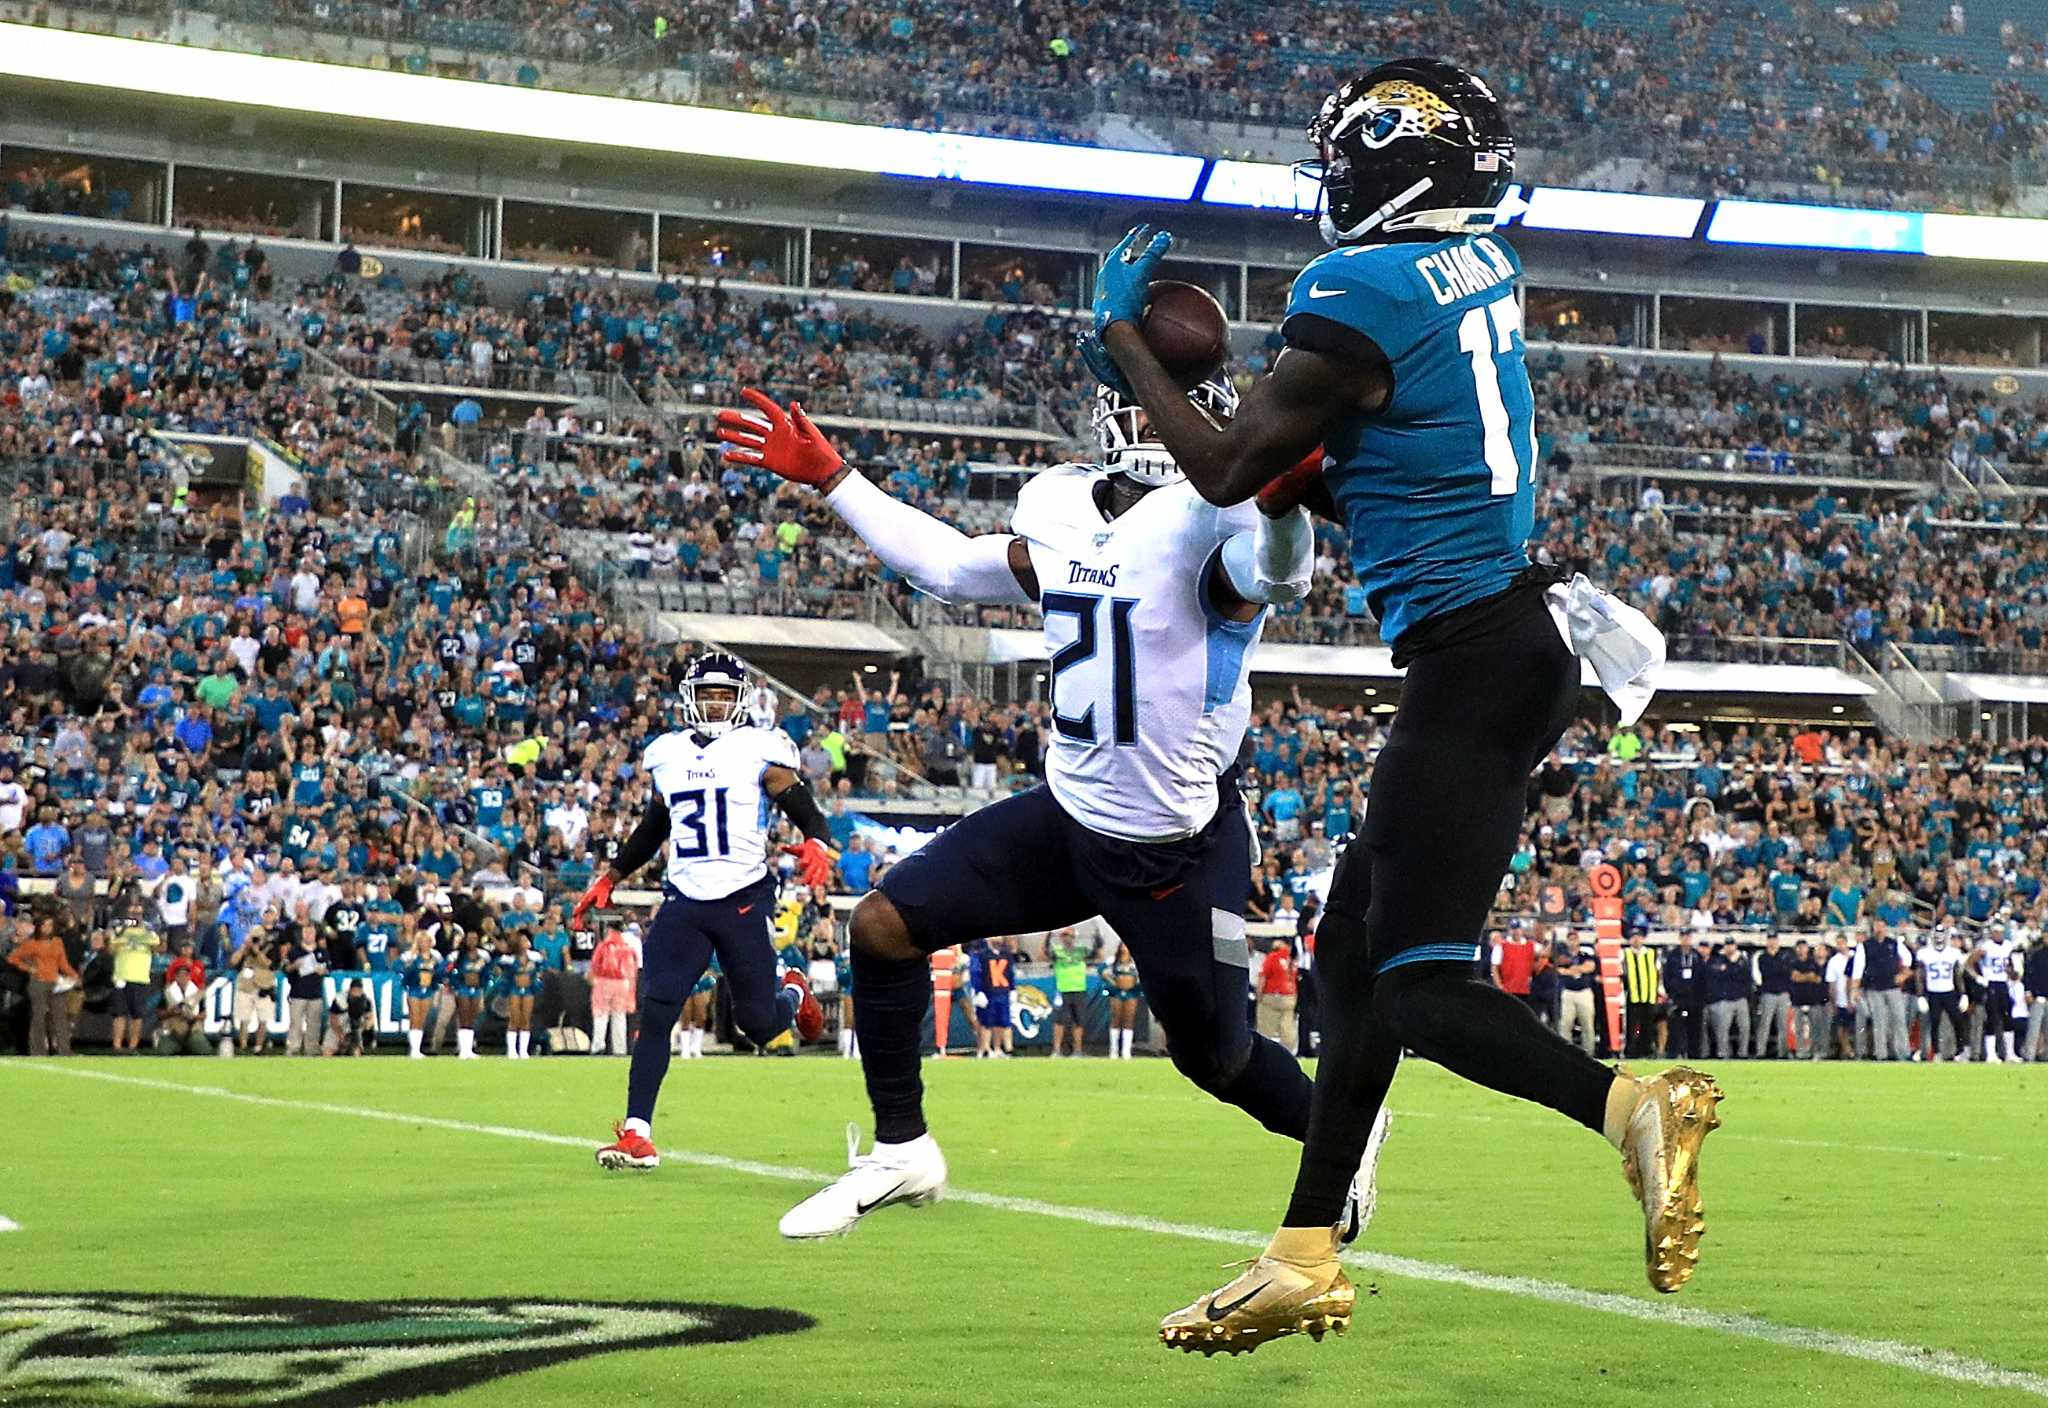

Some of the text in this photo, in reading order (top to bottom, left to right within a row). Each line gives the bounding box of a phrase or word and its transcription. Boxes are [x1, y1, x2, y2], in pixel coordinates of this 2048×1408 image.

[1068, 560, 1120, 588] TITANS
[1042, 589, 1142, 747] 21
[670, 786, 730, 858] 31
[336, 910, 360, 931] 32
[367, 933, 389, 953] 27
[988, 959, 1009, 987] K
[1928, 961, 1953, 980] 53
